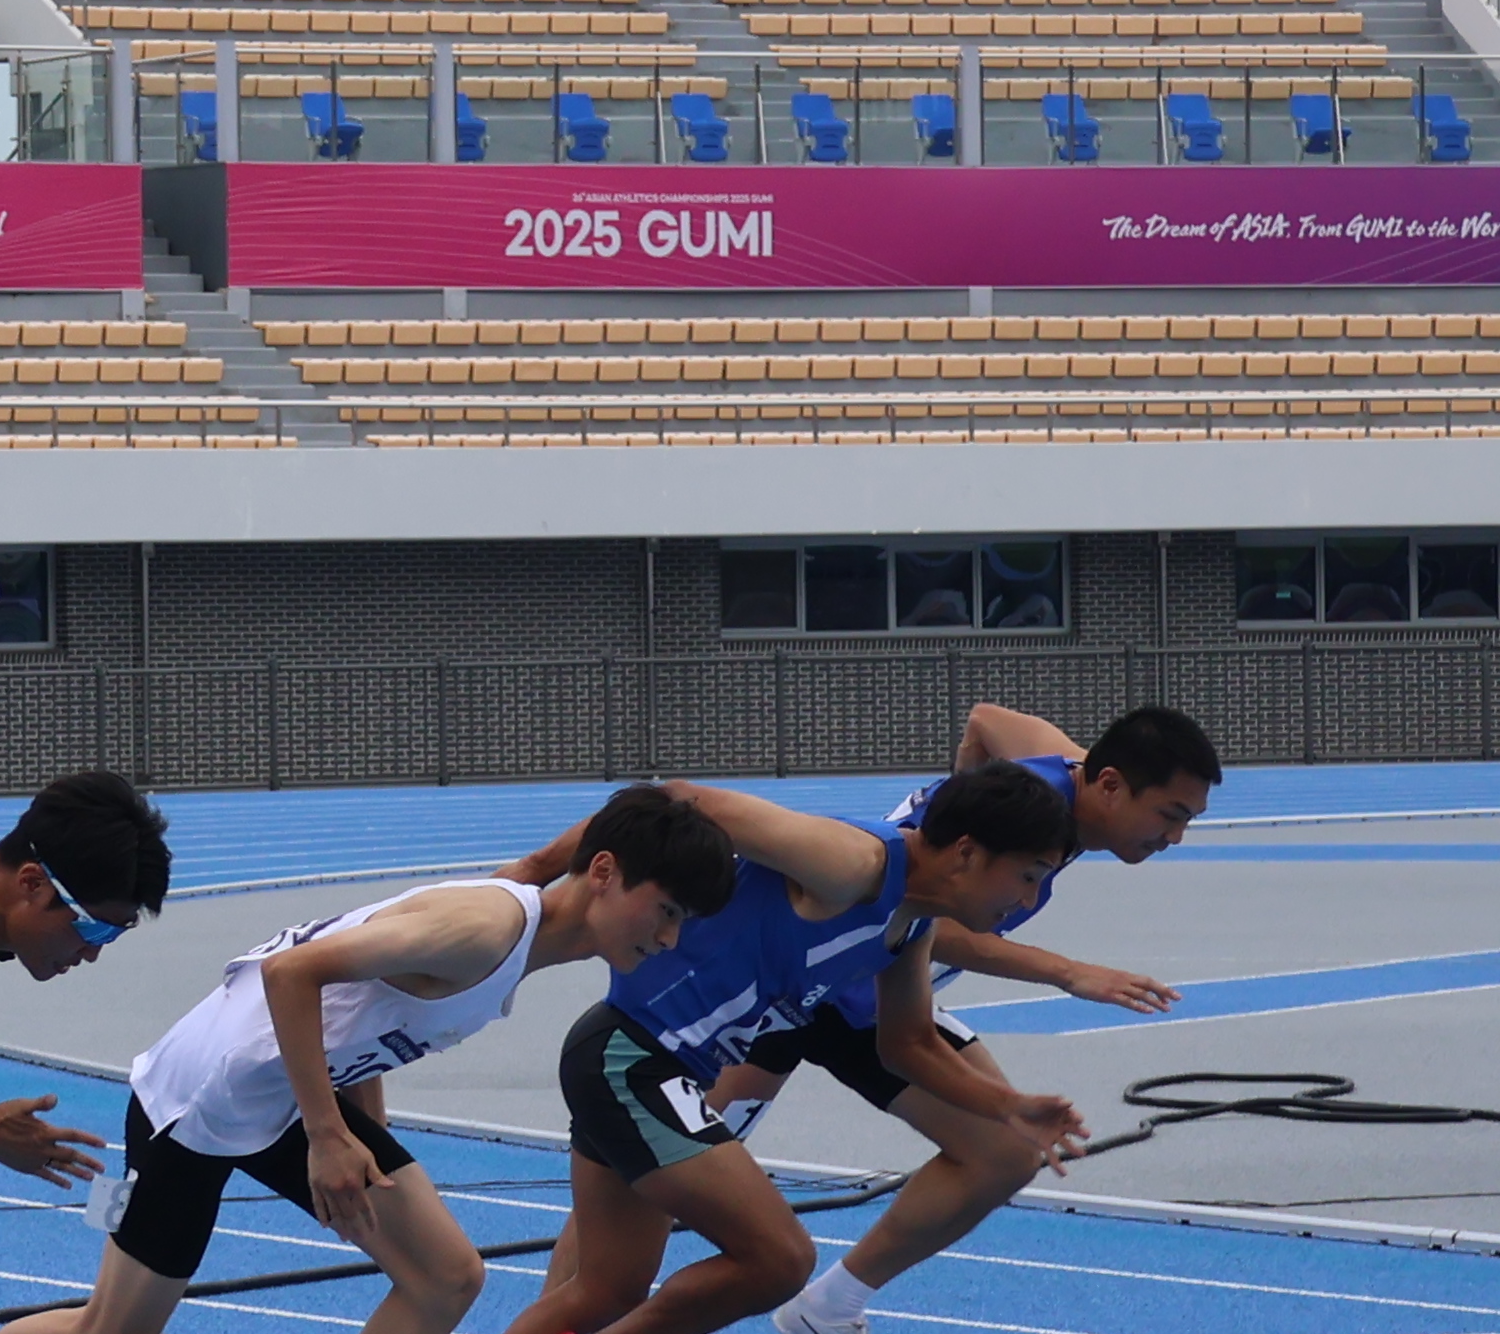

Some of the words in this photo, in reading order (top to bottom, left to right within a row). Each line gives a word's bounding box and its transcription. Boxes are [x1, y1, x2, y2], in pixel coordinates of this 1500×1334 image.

[504, 209, 622, 257] 2025
[638, 209, 773, 258] GUMI
[1103, 214, 1143, 240] The
[1145, 215, 1206, 238] Dream
[1209, 214, 1236, 241] of
[1299, 215, 1343, 239] From
[1345, 215, 1402, 242] GUMI
[1406, 219, 1426, 238] to
[1428, 217, 1458, 238] the
